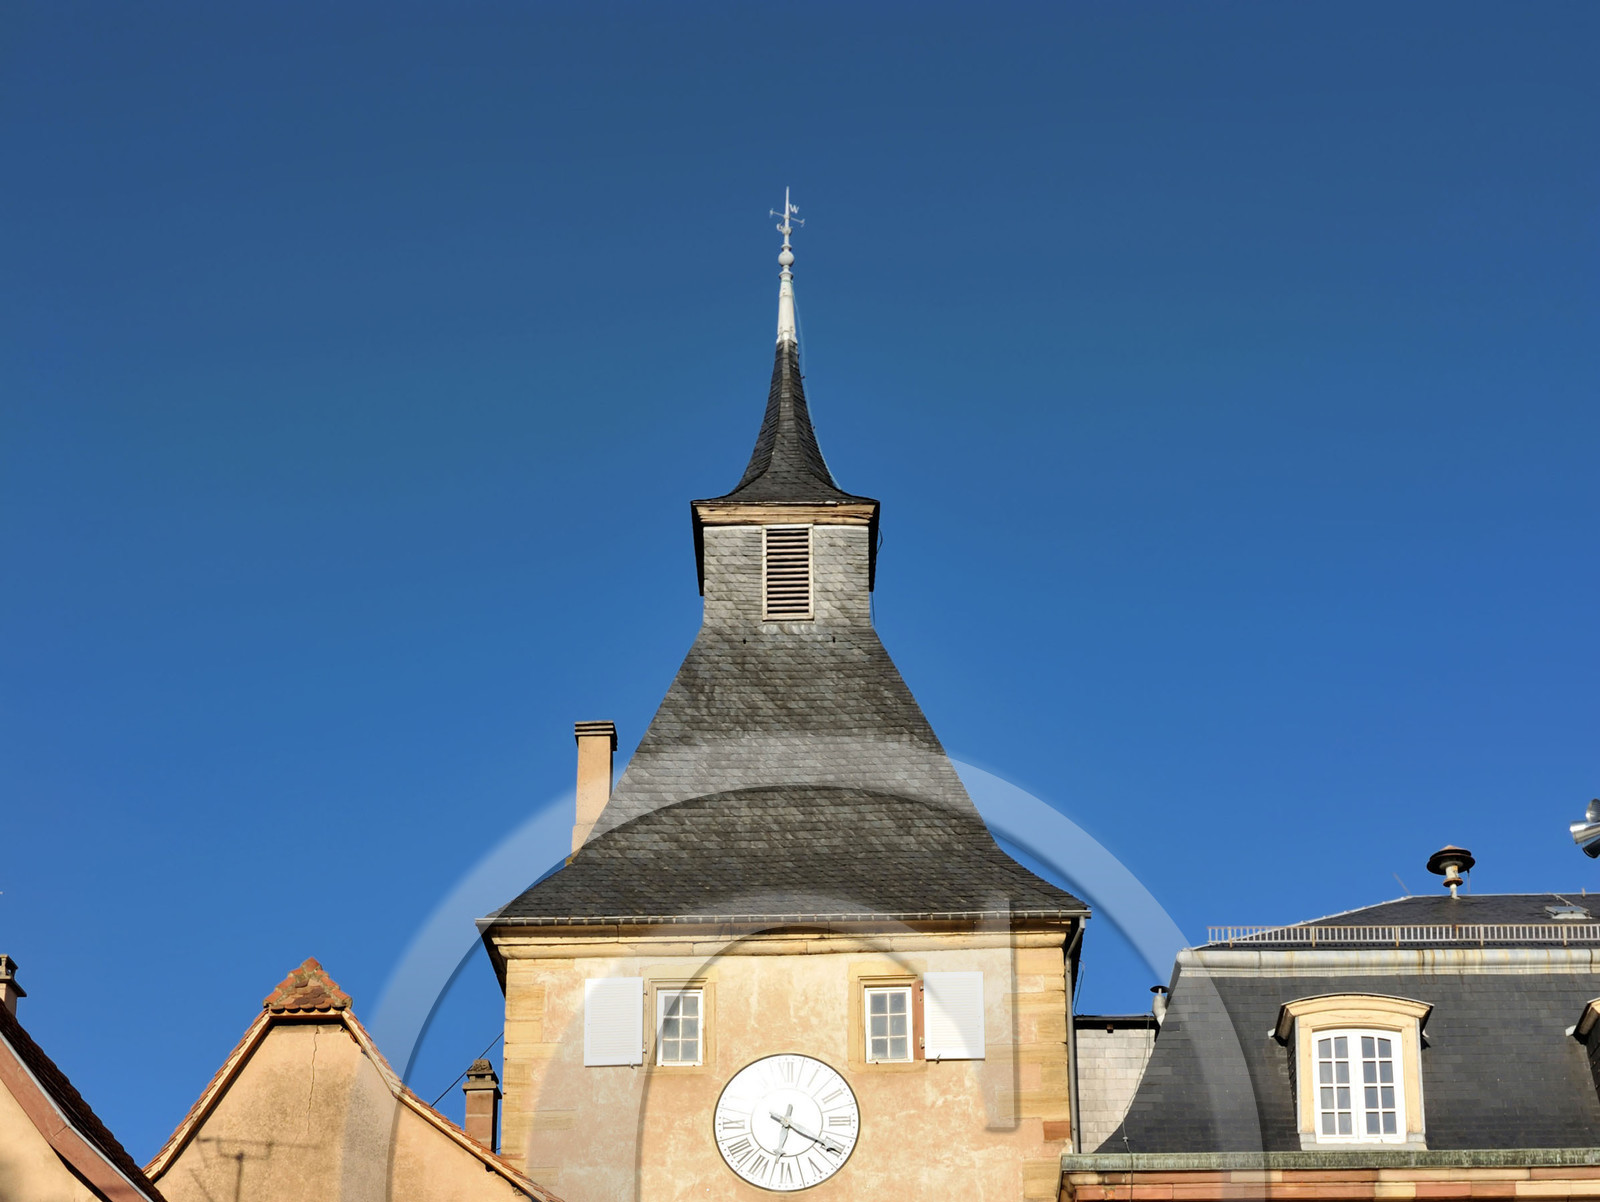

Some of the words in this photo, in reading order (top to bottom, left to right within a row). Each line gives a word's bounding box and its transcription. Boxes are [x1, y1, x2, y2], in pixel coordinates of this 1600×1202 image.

[722, 1116, 745, 1130] IX
[828, 1115, 852, 1127] III
[727, 1137, 756, 1164] VIII
[747, 1153, 770, 1179] VII
[779, 1161, 794, 1184] VI
[807, 1156, 824, 1177] V
